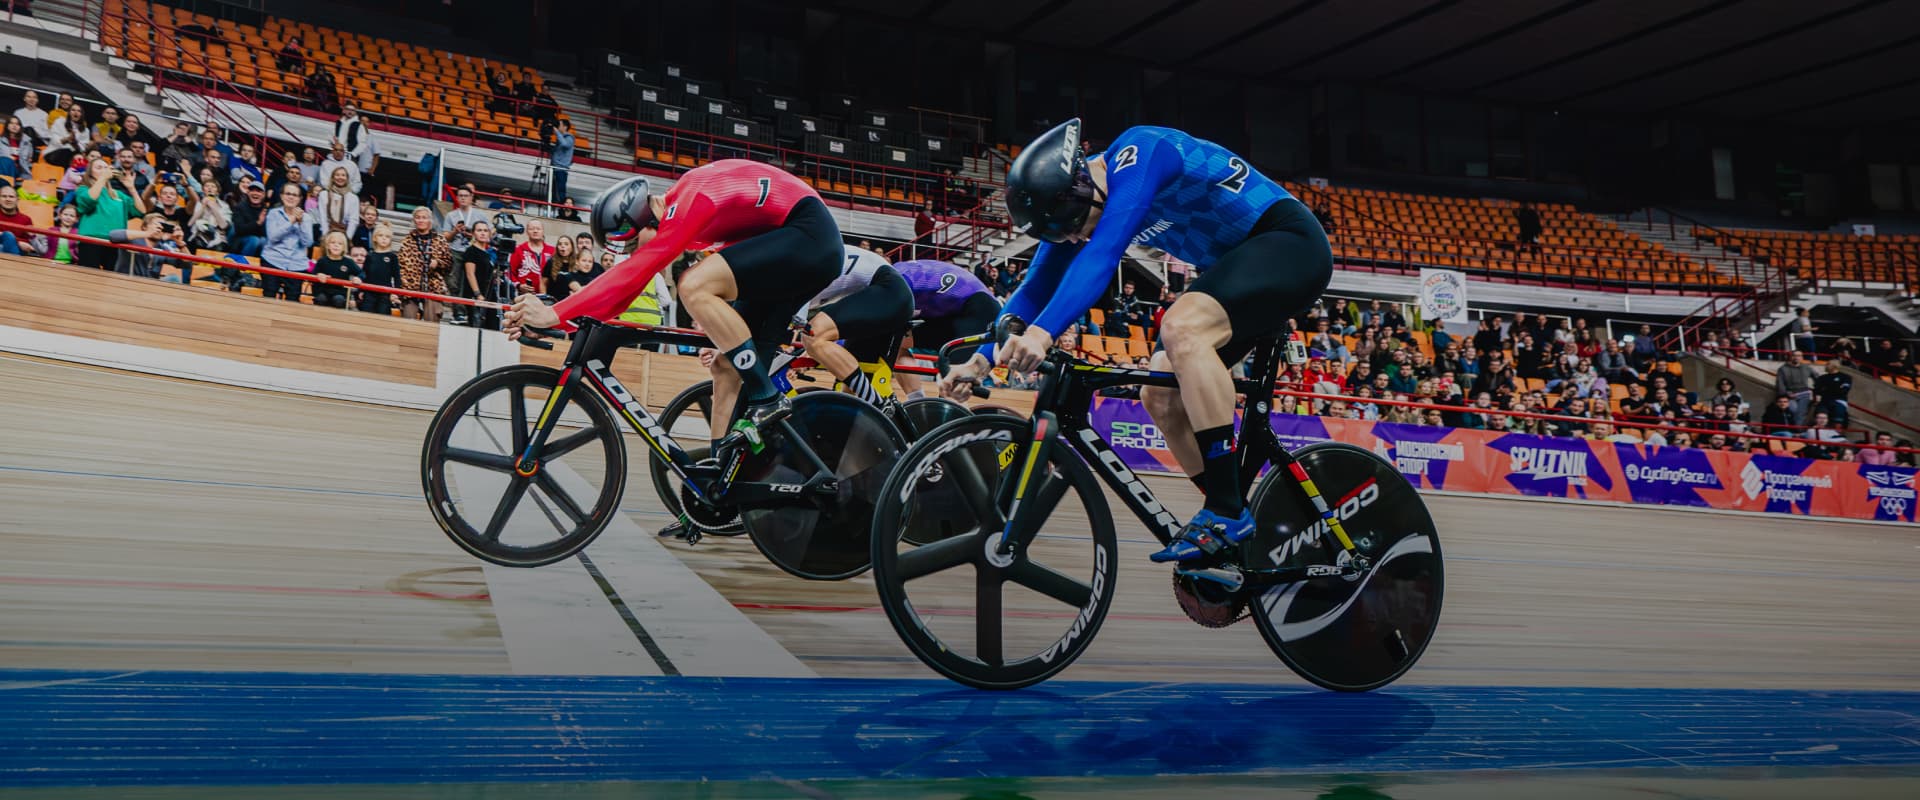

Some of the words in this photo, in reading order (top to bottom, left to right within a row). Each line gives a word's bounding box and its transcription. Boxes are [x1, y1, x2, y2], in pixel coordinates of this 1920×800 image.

[1061, 125, 1077, 174] LAZER
[1113, 145, 1138, 174] 2
[1216, 157, 1249, 194] 2
[756, 178, 771, 207] 1
[665, 203, 678, 220] 1
[1131, 219, 1174, 244] PUTNIK
[847, 255, 860, 275] 7
[937, 273, 958, 293] 9
[587, 359, 683, 455] LOOK
[1111, 421, 1164, 440] SPO
[723, 454, 740, 483] LOOK
[1510, 446, 1588, 477] SPUTNIK
[769, 483, 803, 493] T20
[1078, 428, 1181, 539] LOOK
[1040, 543, 1107, 663] CORIMA
